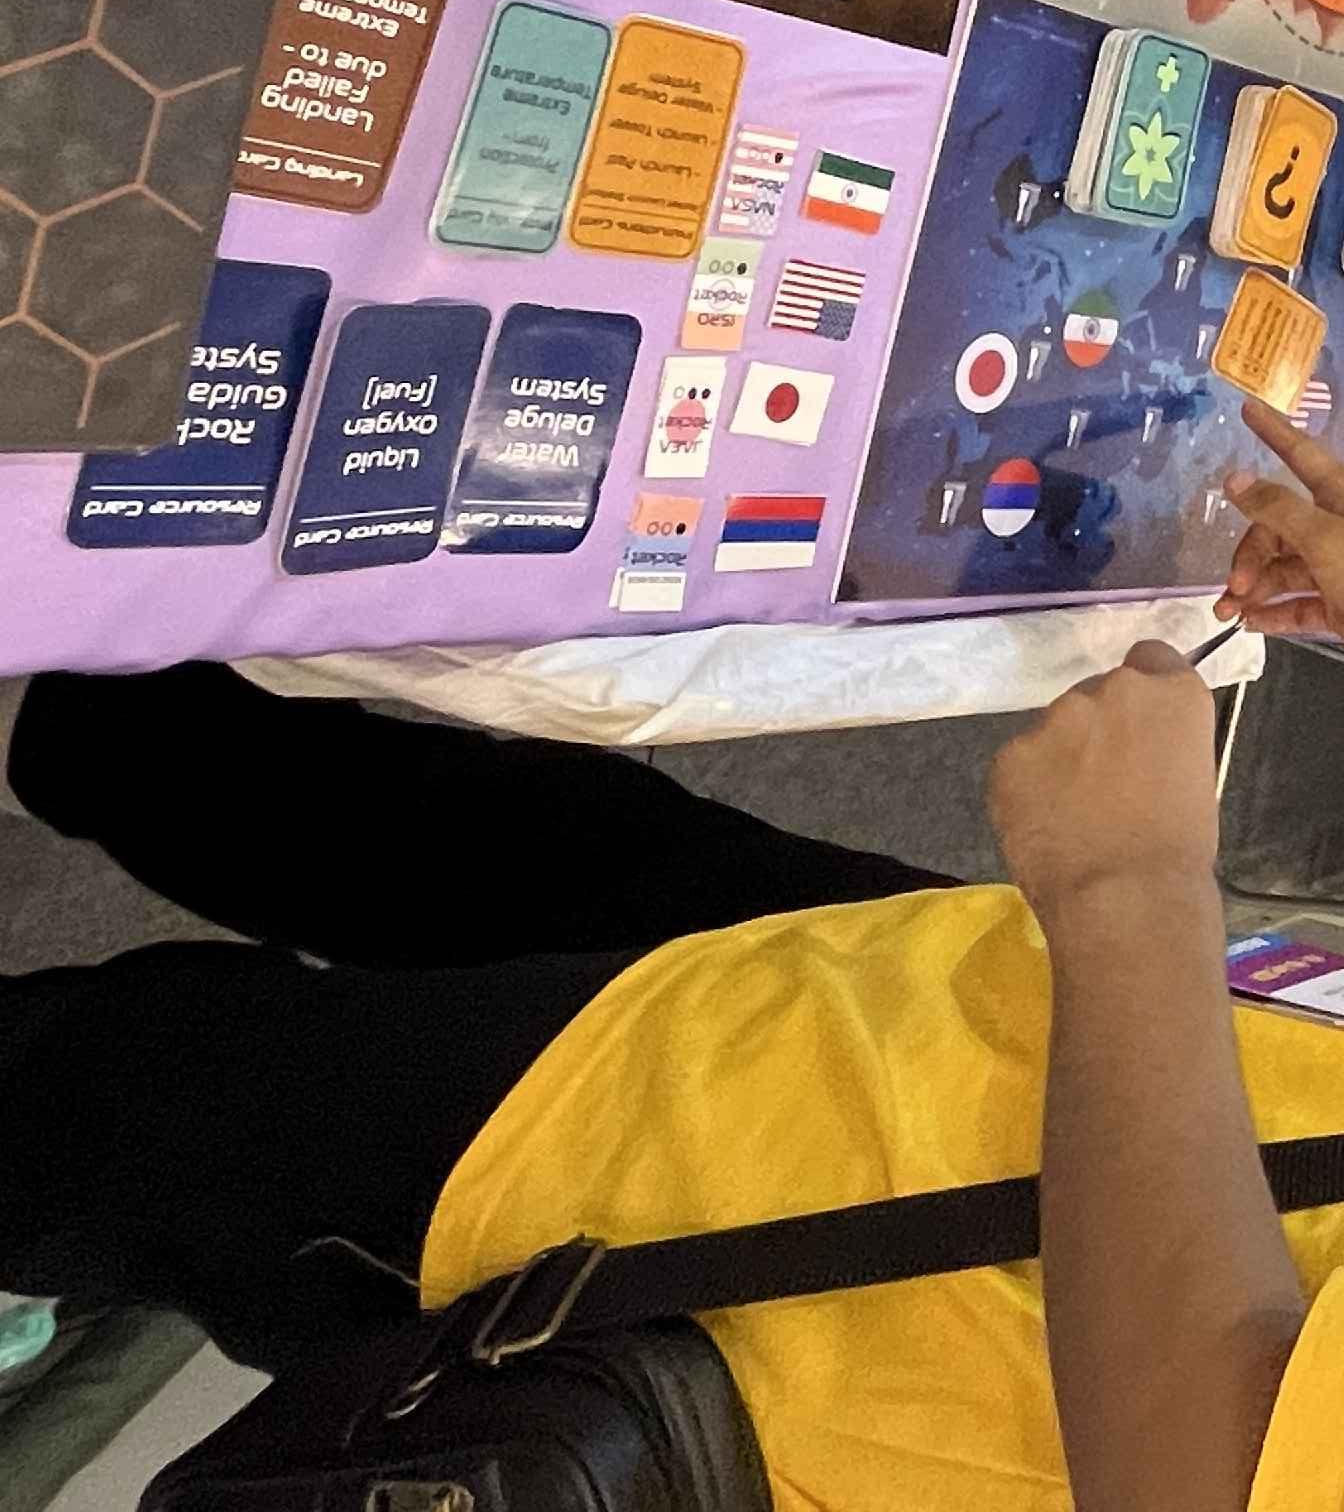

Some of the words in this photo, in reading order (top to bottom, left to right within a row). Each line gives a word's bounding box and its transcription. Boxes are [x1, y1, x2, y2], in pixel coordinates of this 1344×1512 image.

[300, 43, 329, 67] to
[334, 51, 387, 81] due
[282, 67, 369, 103] Failed
[489, 64, 592, 101] Temperature
[260, 85, 374, 132] Landing
[502, 88, 571, 116] Extreme
[284, 158, 364, 188] Landing
[731, 198, 776, 216] NASA
[697, 313, 736, 327] ISRO
[190, 342, 282, 374] Syste
[187, 383, 287, 409] Guida
[362, 374, 438, 410] [Fuel]
[510, 377, 607, 405] System
[343, 411, 438, 435] Oxygen
[504, 404, 595, 436] Deluge
[342, 446, 419, 475] Liquid
[495, 441, 580, 467] Water
[82, 500, 144, 517] Card
[148, 500, 262, 515] Resource
[455, 512, 500, 527] Card
[346, 518, 433, 538] Resource
[502, 514, 586, 529] Resource
[293, 529, 342, 547] Card
